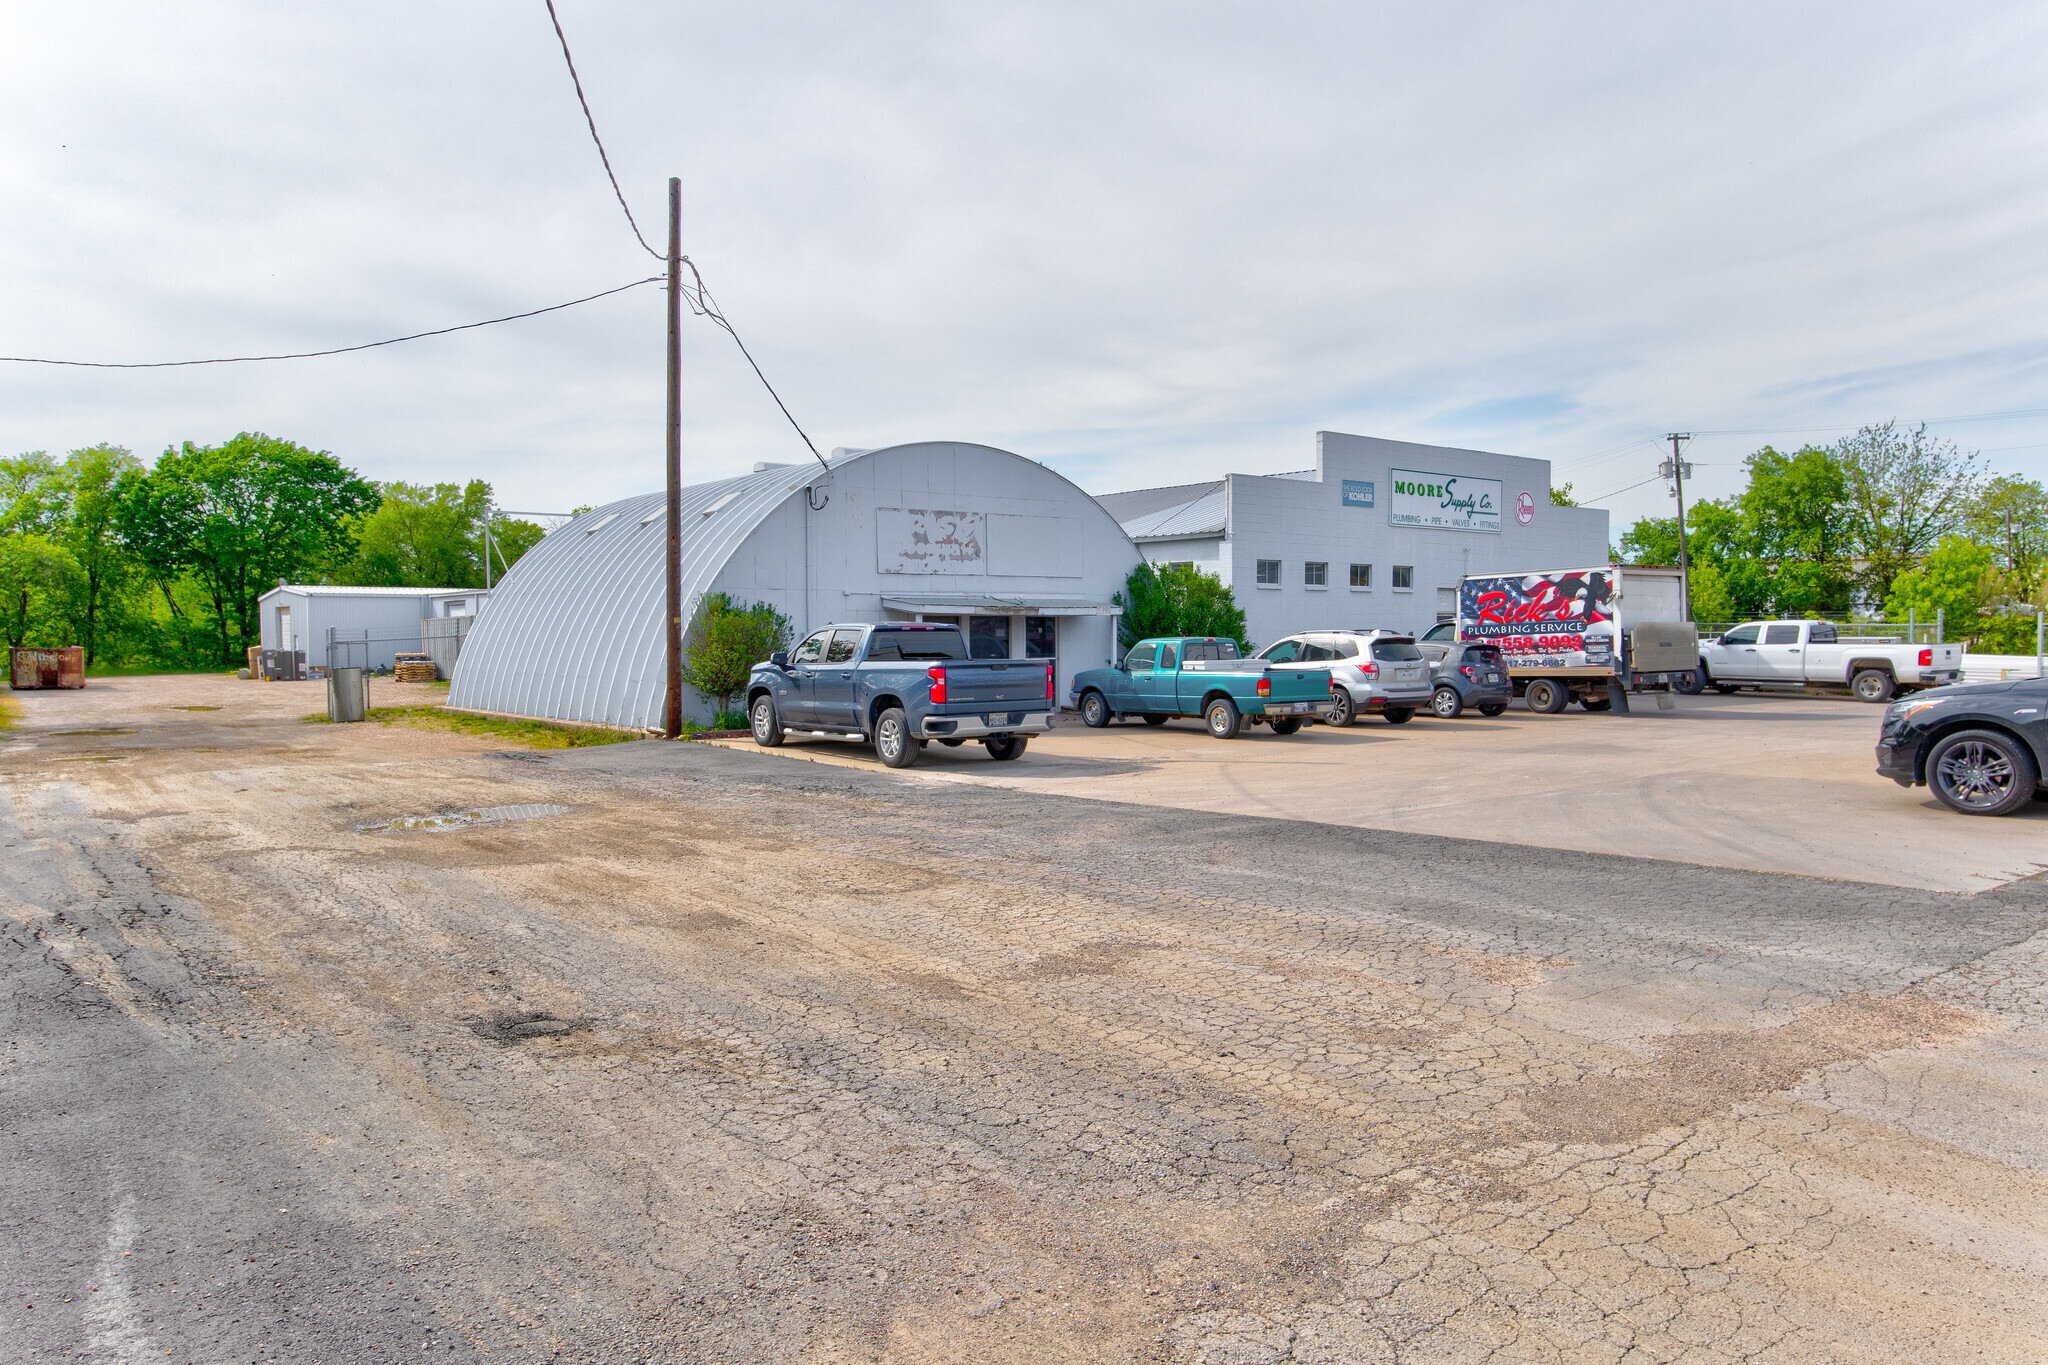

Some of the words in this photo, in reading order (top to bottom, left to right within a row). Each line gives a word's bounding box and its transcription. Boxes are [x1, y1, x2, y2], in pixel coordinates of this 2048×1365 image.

[1348, 491, 1374, 502] KOHLER
[1394, 480, 1443, 498] MOORE
[1441, 478, 1476, 516] Supply
[1479, 493, 1493, 509] Co.
[1392, 513, 1421, 524] PLUMBING
[1431, 516, 1442, 526] PIPE
[1451, 518, 1471, 528] VALVES
[1479, 520, 1500, 530] FITTINGS
[1477, 589, 1573, 626] Rick's
[1468, 623, 1530, 635] PLUMBING
[1534, 621, 1583, 633] SERVICE
[1502, 634, 1583, 648] 558-9093
